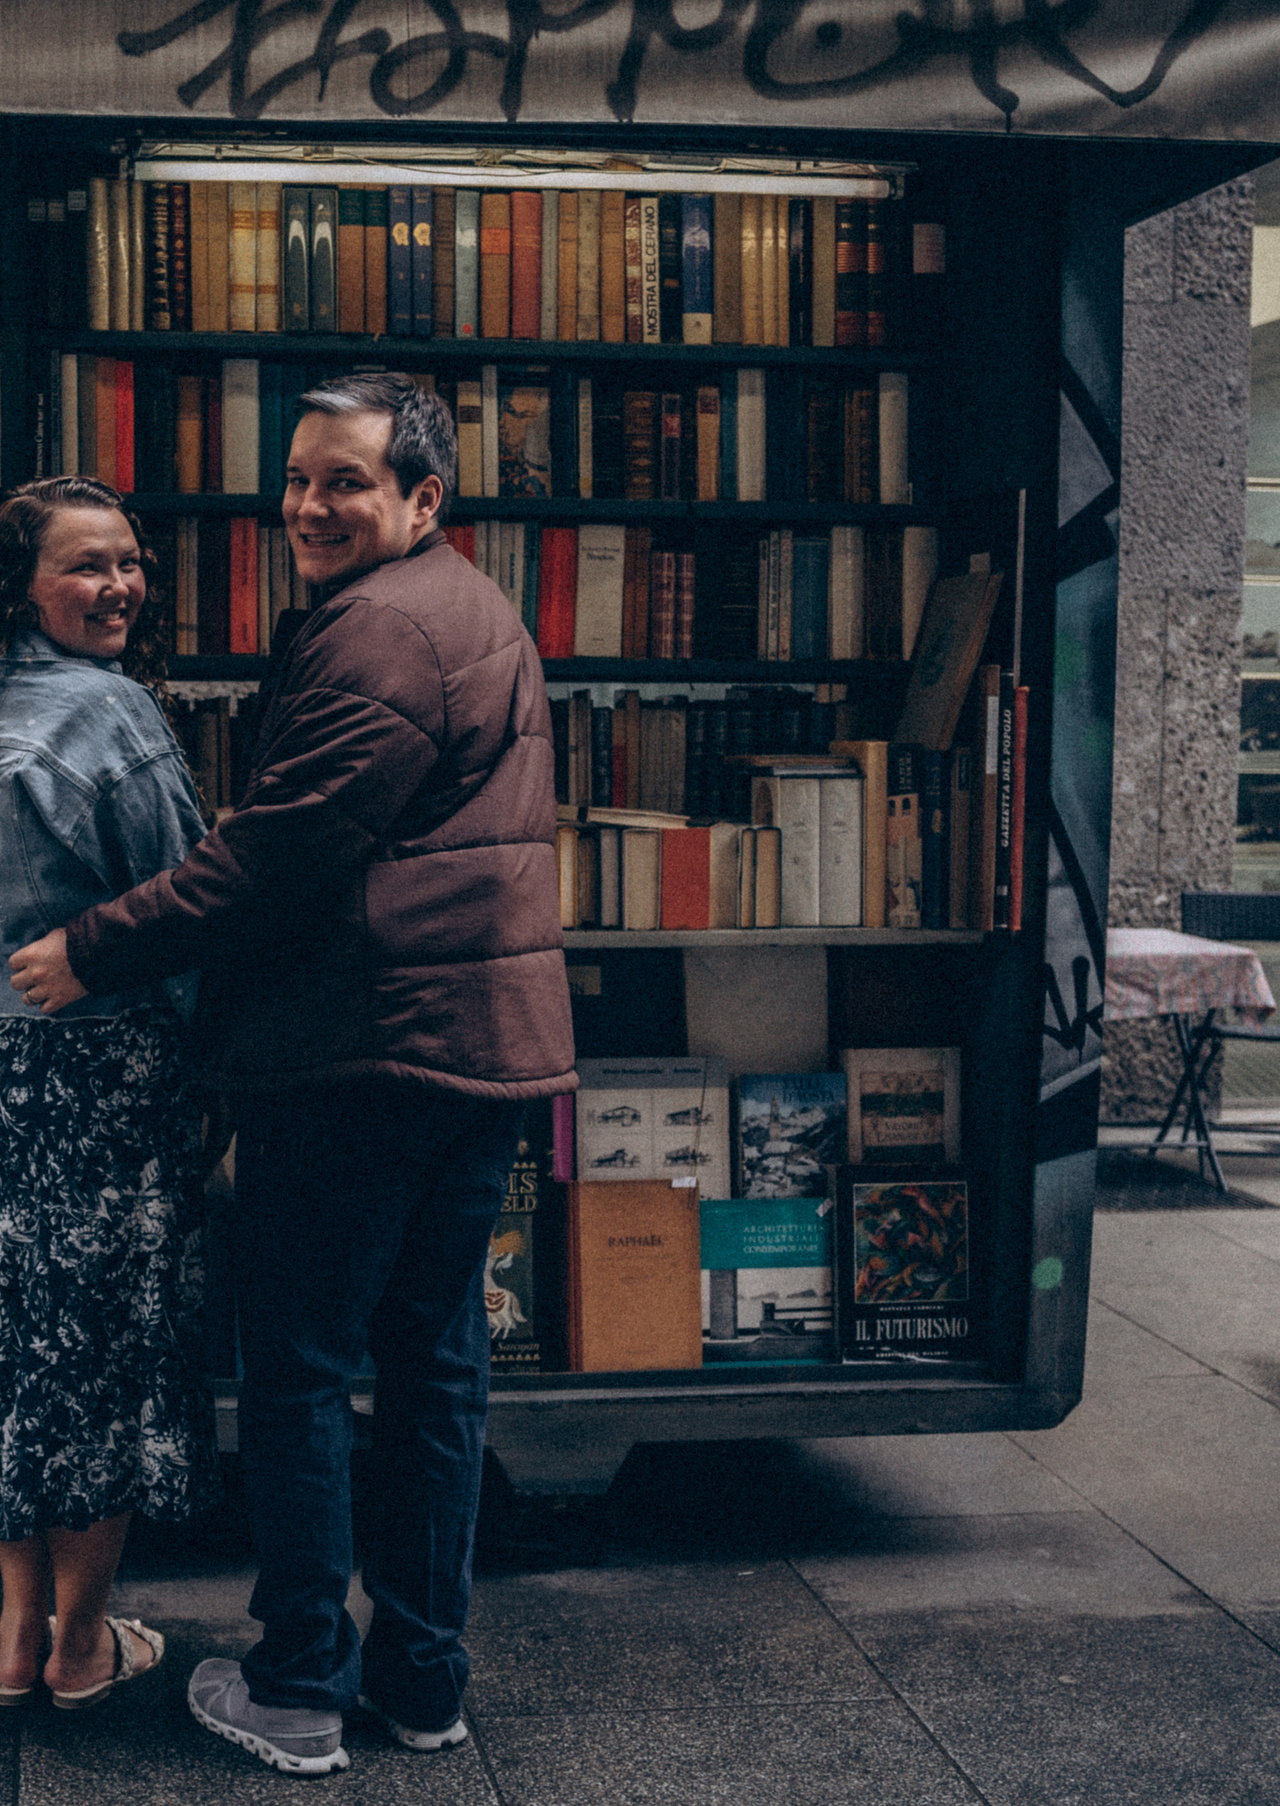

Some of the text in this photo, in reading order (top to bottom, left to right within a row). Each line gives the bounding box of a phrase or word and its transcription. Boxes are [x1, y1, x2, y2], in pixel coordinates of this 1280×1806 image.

[644, 205, 658, 336] MOSTRA DEL CERANO
[1000, 708, 1013, 848] GAZZETTA DEL POPOLO
[497, 1343, 540, 1352] Saroyan
[855, 1317, 969, 1341] IL FUTURISMO
